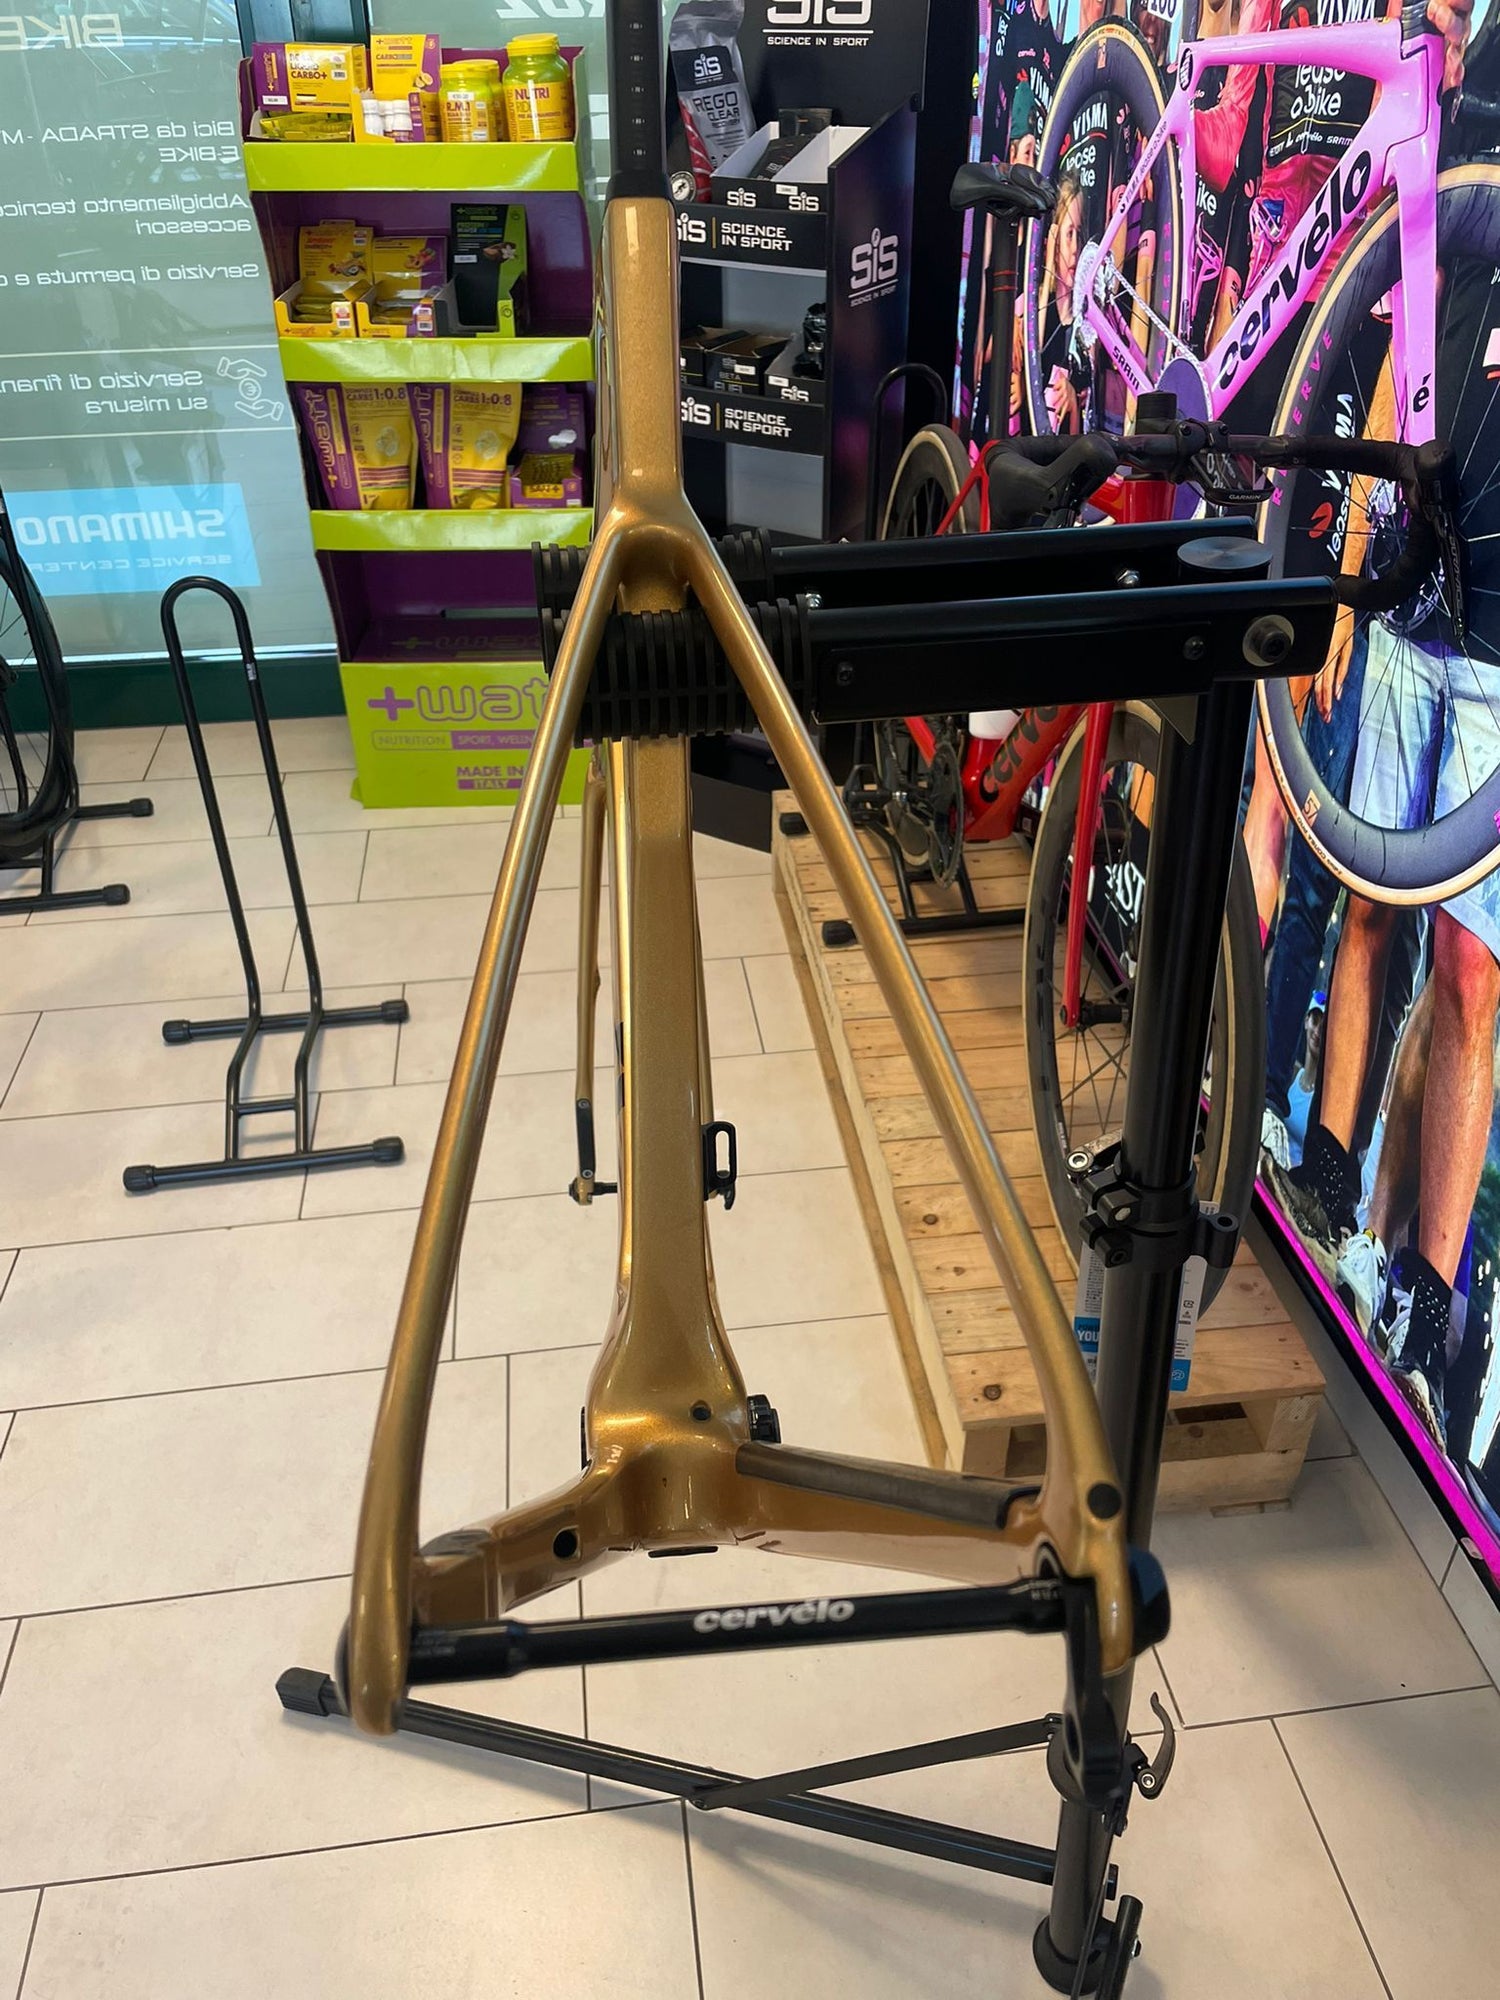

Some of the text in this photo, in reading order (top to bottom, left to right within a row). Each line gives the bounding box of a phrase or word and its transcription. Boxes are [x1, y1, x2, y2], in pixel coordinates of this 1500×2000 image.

[767, 37, 869, 46] SCIENCE IN SPORT
[291, 71, 327, 80] CARBO+
[694, 53, 721, 78] SiS
[515, 87, 550, 100] NUTRI
[692, 91, 738, 112] REGO
[1303, 84, 1341, 117] bike
[708, 107, 740, 121] CLEAR
[1072, 103, 1107, 140] VISMA
[1080, 167, 1096, 187] ike
[727, 188, 819, 211] SiS SiS
[1196, 181, 1217, 216] ike
[721, 222, 787, 239] SCIENCE
[722, 234, 793, 251] IN SPORT
[851, 227, 898, 289] SiS
[1219, 150, 1371, 390] cervélo
[1112, 346, 1140, 390] SRAM
[374, 387, 406, 400] 1:0.8
[725, 408, 787, 426] SCIENCE
[1270, 332, 1333, 506] RERVE
[725, 419, 792, 438] IN SPORT
[1321, 393, 1353, 491] VMA
[1229, 491, 1261, 500] GARMIN
[367, 677, 549, 722] +wat
[379, 735, 446, 746] NUTRITION
[497, 735, 534, 746] WELLN
[979, 706, 1058, 803] cerv
[456, 766, 524, 777] MADE IN
[693, 1598, 855, 1634] cervélo
